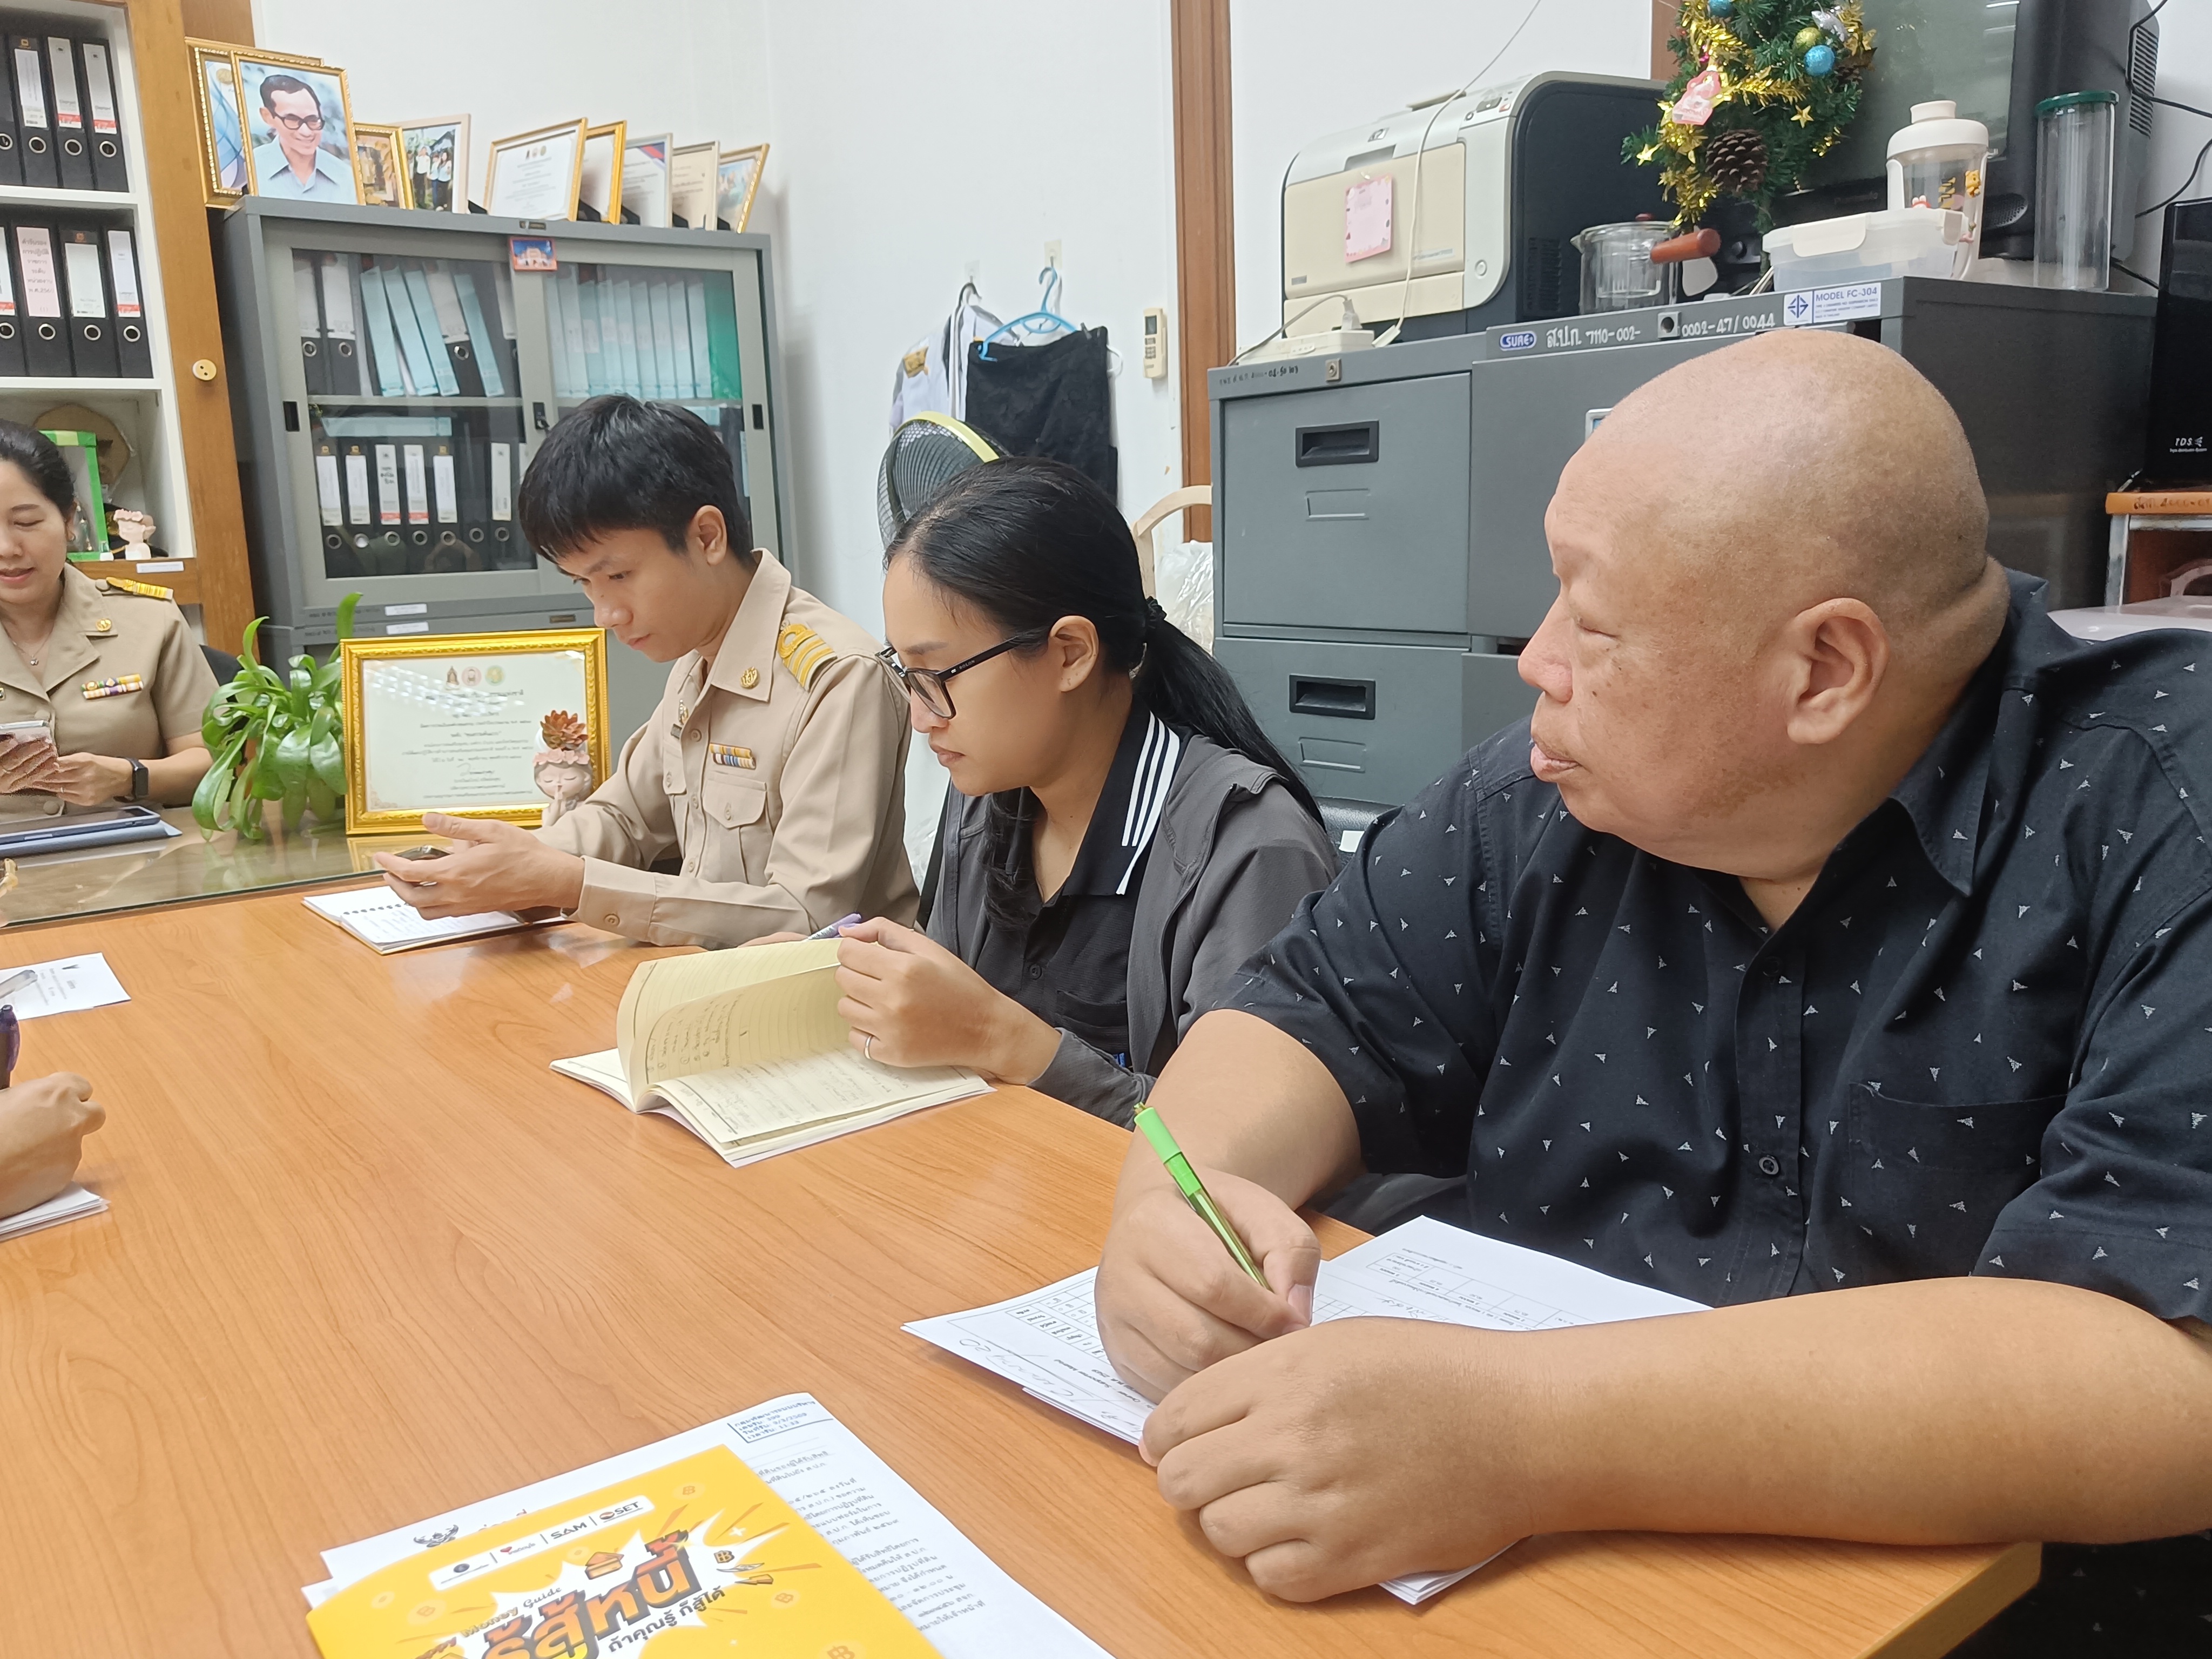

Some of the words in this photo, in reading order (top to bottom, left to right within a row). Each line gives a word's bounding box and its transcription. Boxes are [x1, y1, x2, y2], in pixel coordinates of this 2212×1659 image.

[1816, 291, 1844, 301] MODEL
[1847, 287, 1877, 298] FC-304
[1506, 333, 1529, 347] SURE
[1546, 325, 1582, 348] ส.ป.ก.
[615, 1501, 638, 1515] SET
[551, 1522, 588, 1539] SAM
[460, 1607, 518, 1638] Money
[523, 1587, 562, 1609] Guide
[609, 1609, 678, 1653] ถ้าคุณรู้
[679, 1585, 726, 1616] ก็สู้ได้
